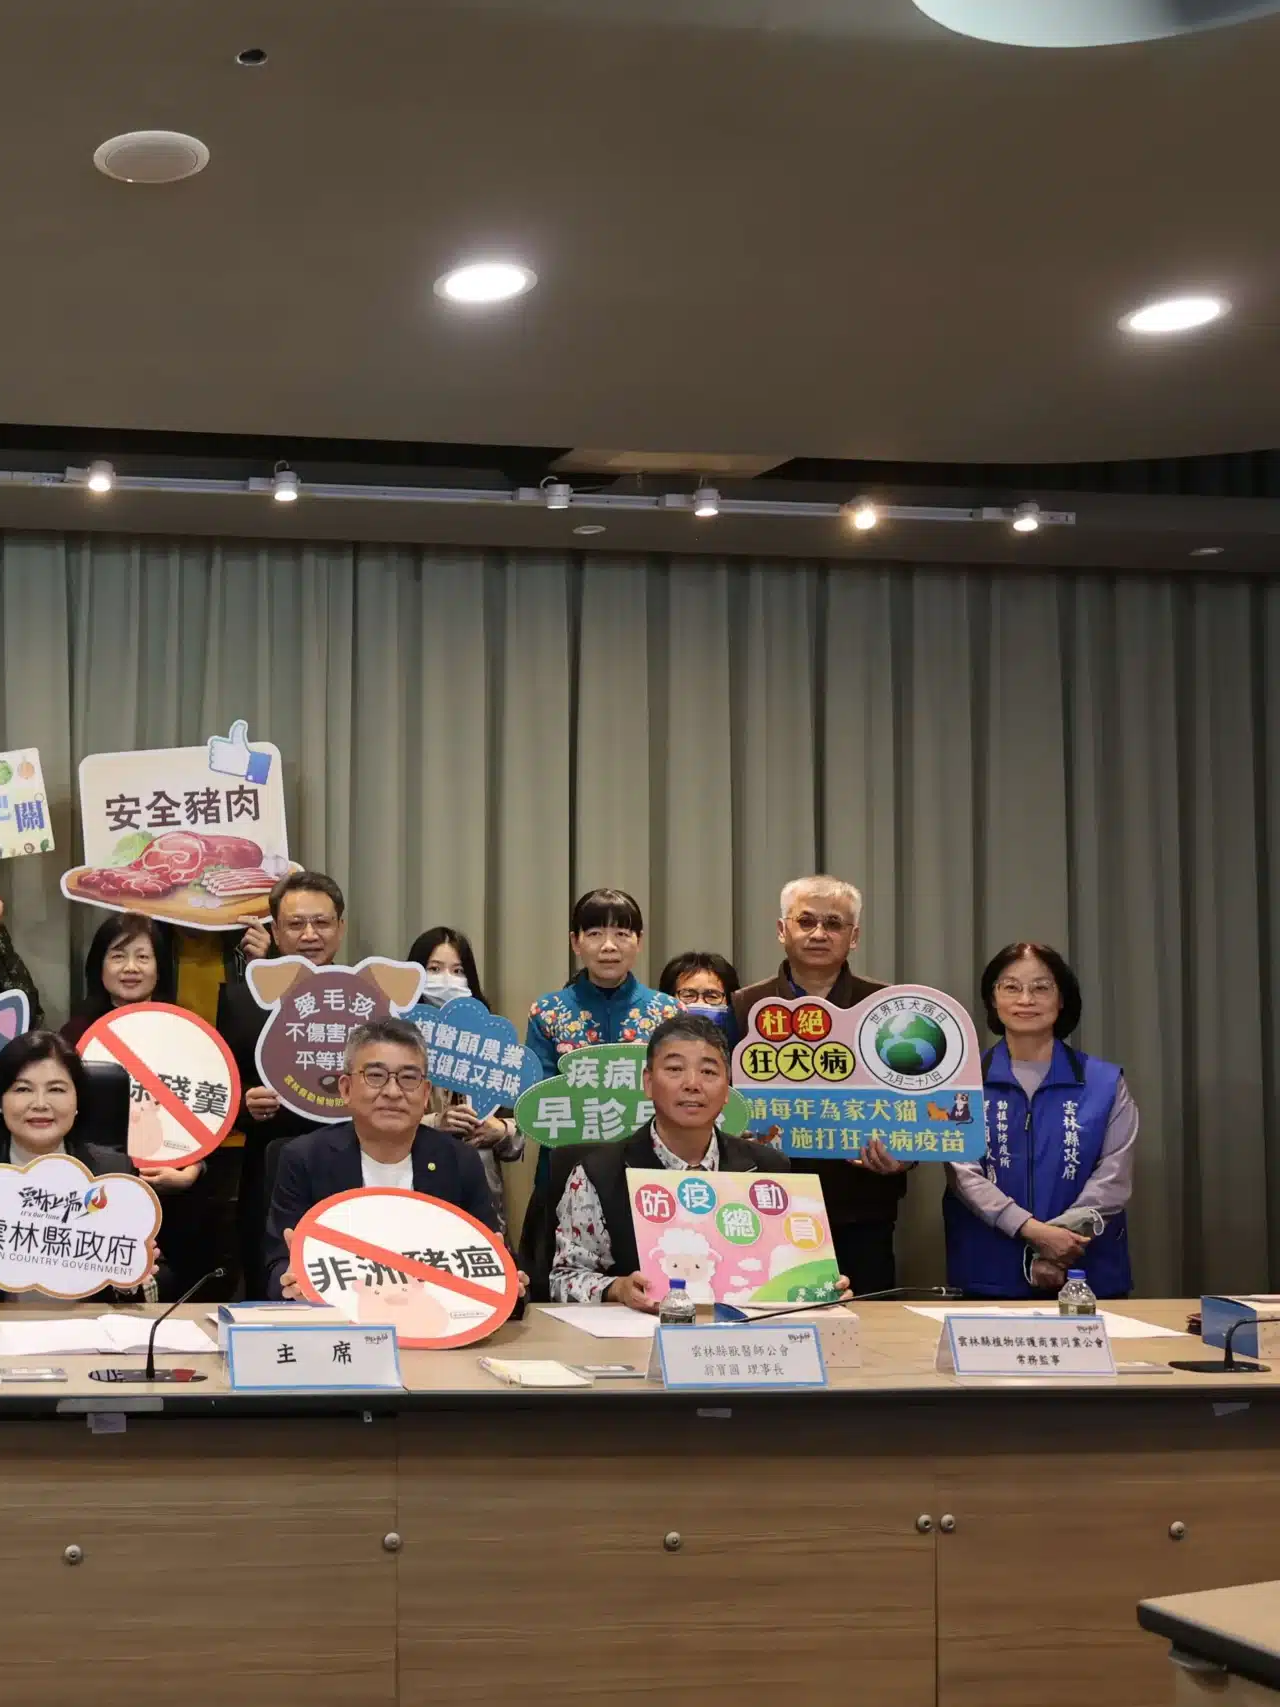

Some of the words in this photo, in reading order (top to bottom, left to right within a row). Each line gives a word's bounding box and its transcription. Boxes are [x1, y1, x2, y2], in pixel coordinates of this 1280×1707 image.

[106, 784, 260, 831] 安全豬肉
[294, 988, 376, 1020] 愛毛孩
[869, 999, 948, 1025] 世界狂犬病日
[285, 1022, 362, 1043] 不傷害
[762, 1010, 825, 1036] 杜絕
[567, 1057, 647, 1090] 疾病
[748, 1048, 847, 1074] 狂犬病
[883, 1070, 943, 1088] 九月二十八日
[749, 1098, 918, 1122] 請每年為家犬貓
[790, 1127, 965, 1153] 施打狂犬病疫苗
[996, 1100, 1011, 1168] 動植物防疫所
[1061, 1100, 1081, 1181] 雲林縣政府
[641, 1183, 818, 1243] 防疫總動員
[9, 1252, 58, 1266] COUNTRY
[62, 1259, 133, 1276] GOVERNMENT
[308, 1245, 505, 1293] 非洲豬瘟
